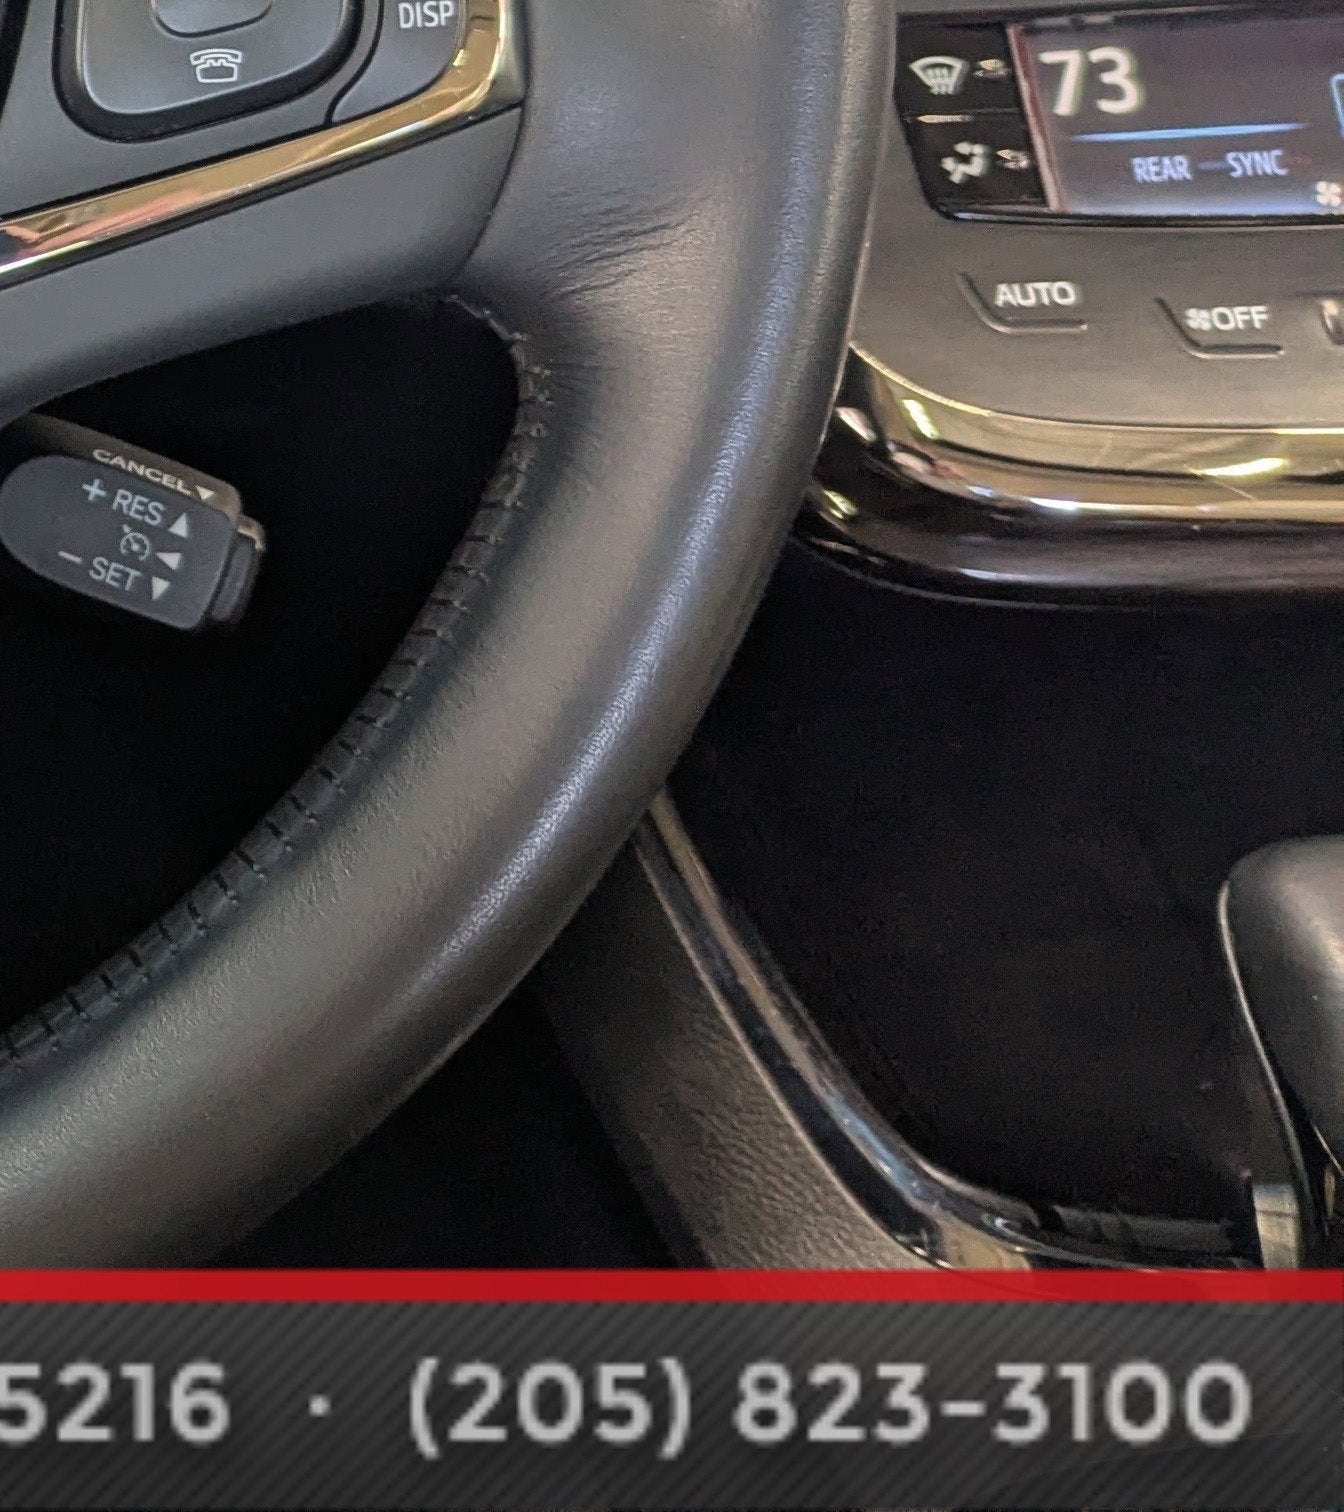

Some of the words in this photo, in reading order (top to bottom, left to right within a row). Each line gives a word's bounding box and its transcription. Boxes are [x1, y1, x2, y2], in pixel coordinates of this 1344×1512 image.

[398, 1, 455, 29] DISP
[1039, 46, 1144, 116] 73
[1132, 155, 1192, 182] REAR
[1226, 149, 1288, 178] SYNC
[994, 281, 1077, 308] AUTO
[1211, 305, 1269, 331] OFF
[92, 448, 192, 495] CANCEL
[111, 489, 164, 526] RES
[88, 556, 141, 591] SET
